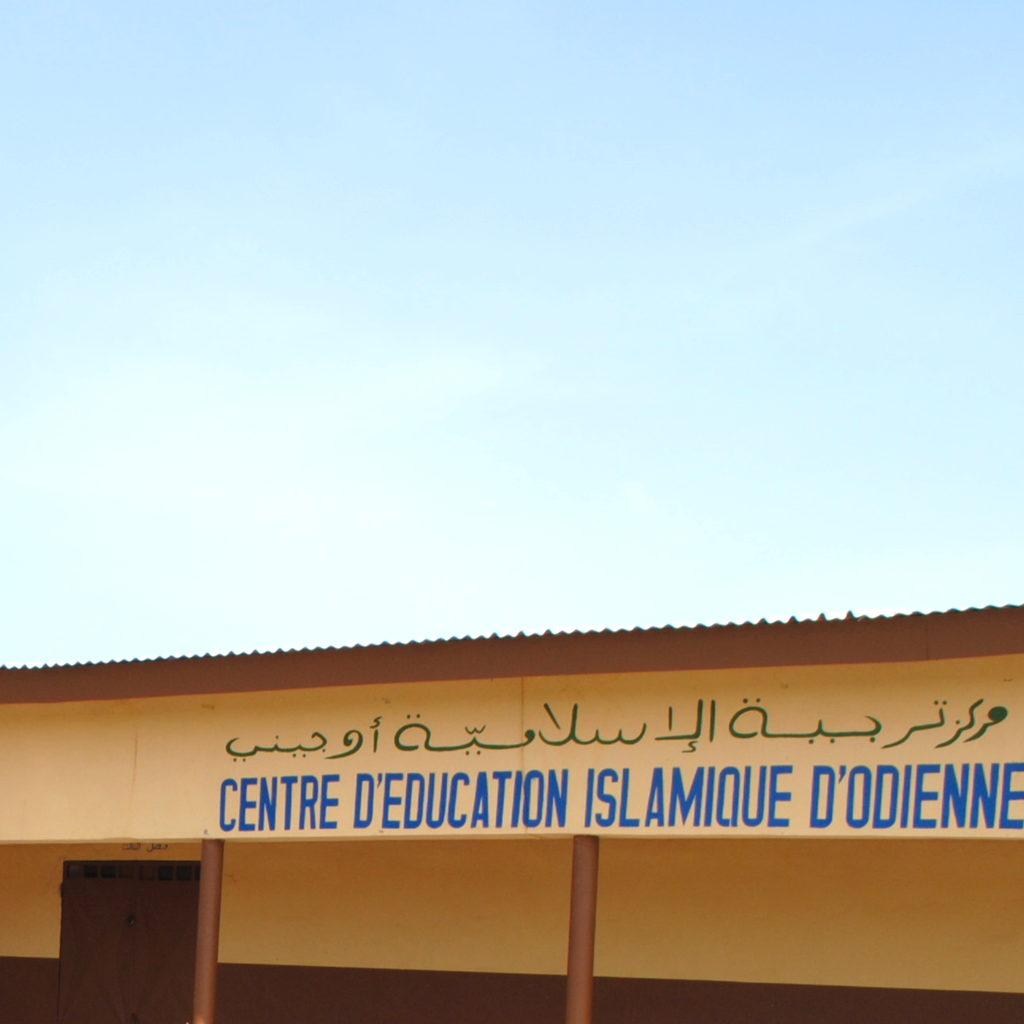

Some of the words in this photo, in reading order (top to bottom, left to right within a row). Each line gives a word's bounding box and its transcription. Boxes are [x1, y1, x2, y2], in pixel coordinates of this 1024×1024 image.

[219, 774, 340, 832] CENTRE
[353, 768, 569, 829] D'EDUCATION
[584, 765, 794, 828] ISLAMIQUE
[809, 762, 1024, 830] D'ODIENNE
